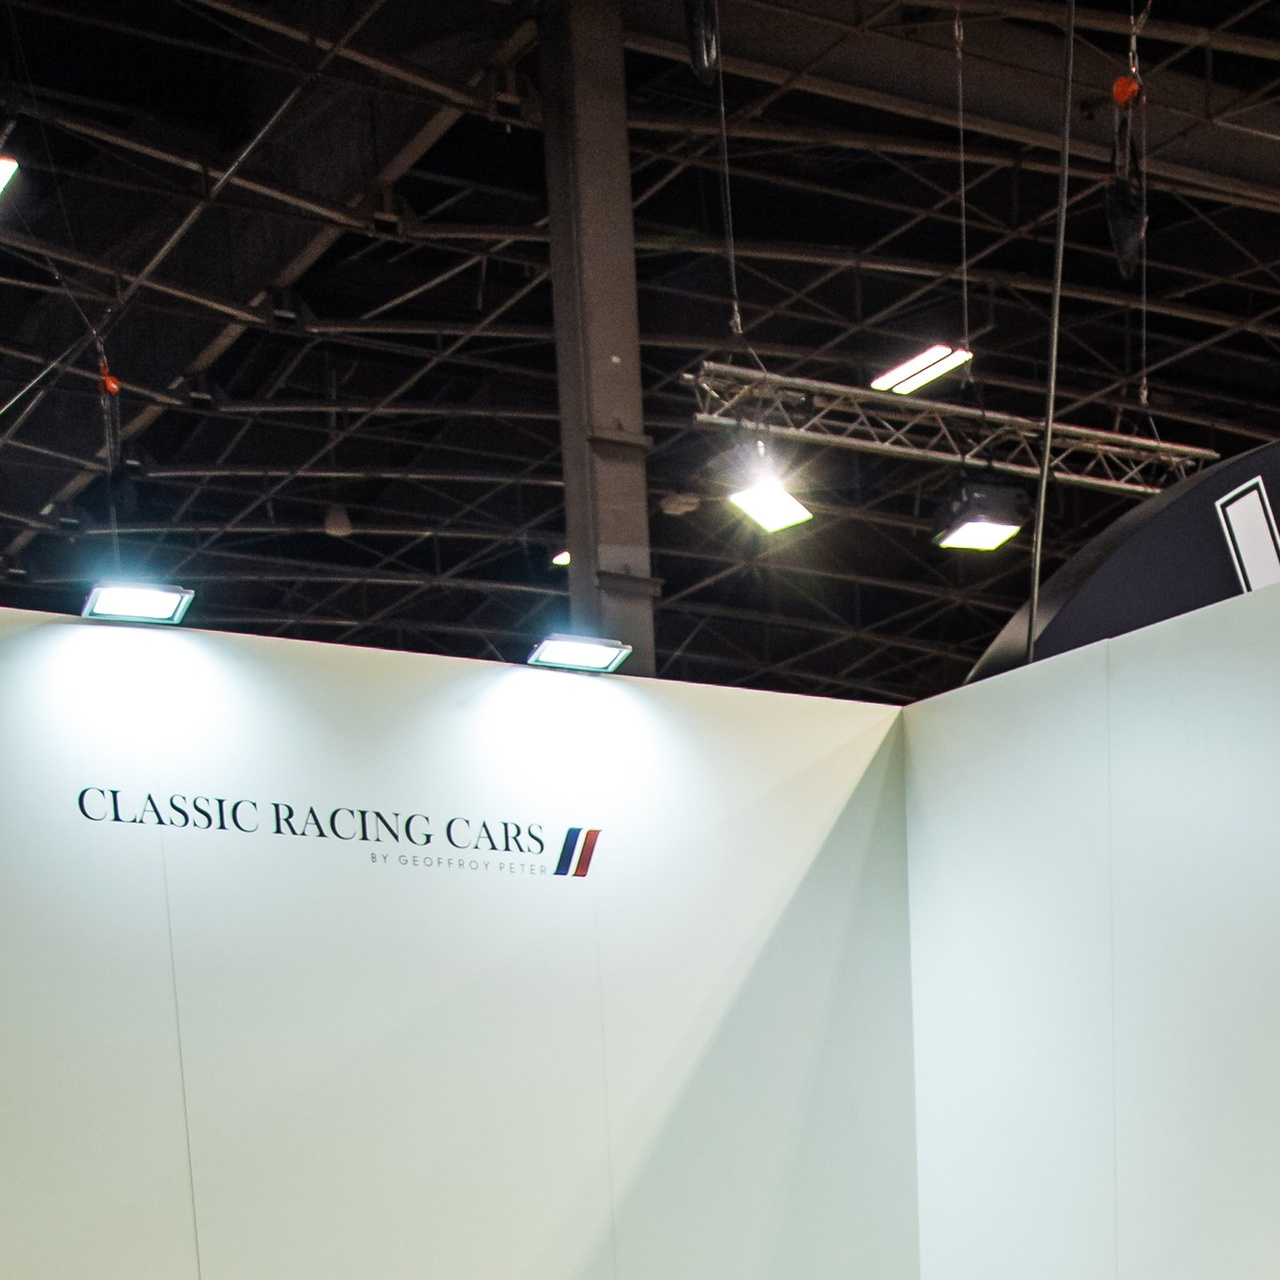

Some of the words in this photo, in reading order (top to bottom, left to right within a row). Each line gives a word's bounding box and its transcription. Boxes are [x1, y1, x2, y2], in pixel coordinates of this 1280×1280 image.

[77, 786, 260, 834] CLASSIC
[271, 802, 435, 847] RACING
[445, 818, 546, 856] CARS
[370, 853, 390, 865] BY
[398, 855, 492, 872] GEOFFROY
[499, 862, 549, 876] PETER
